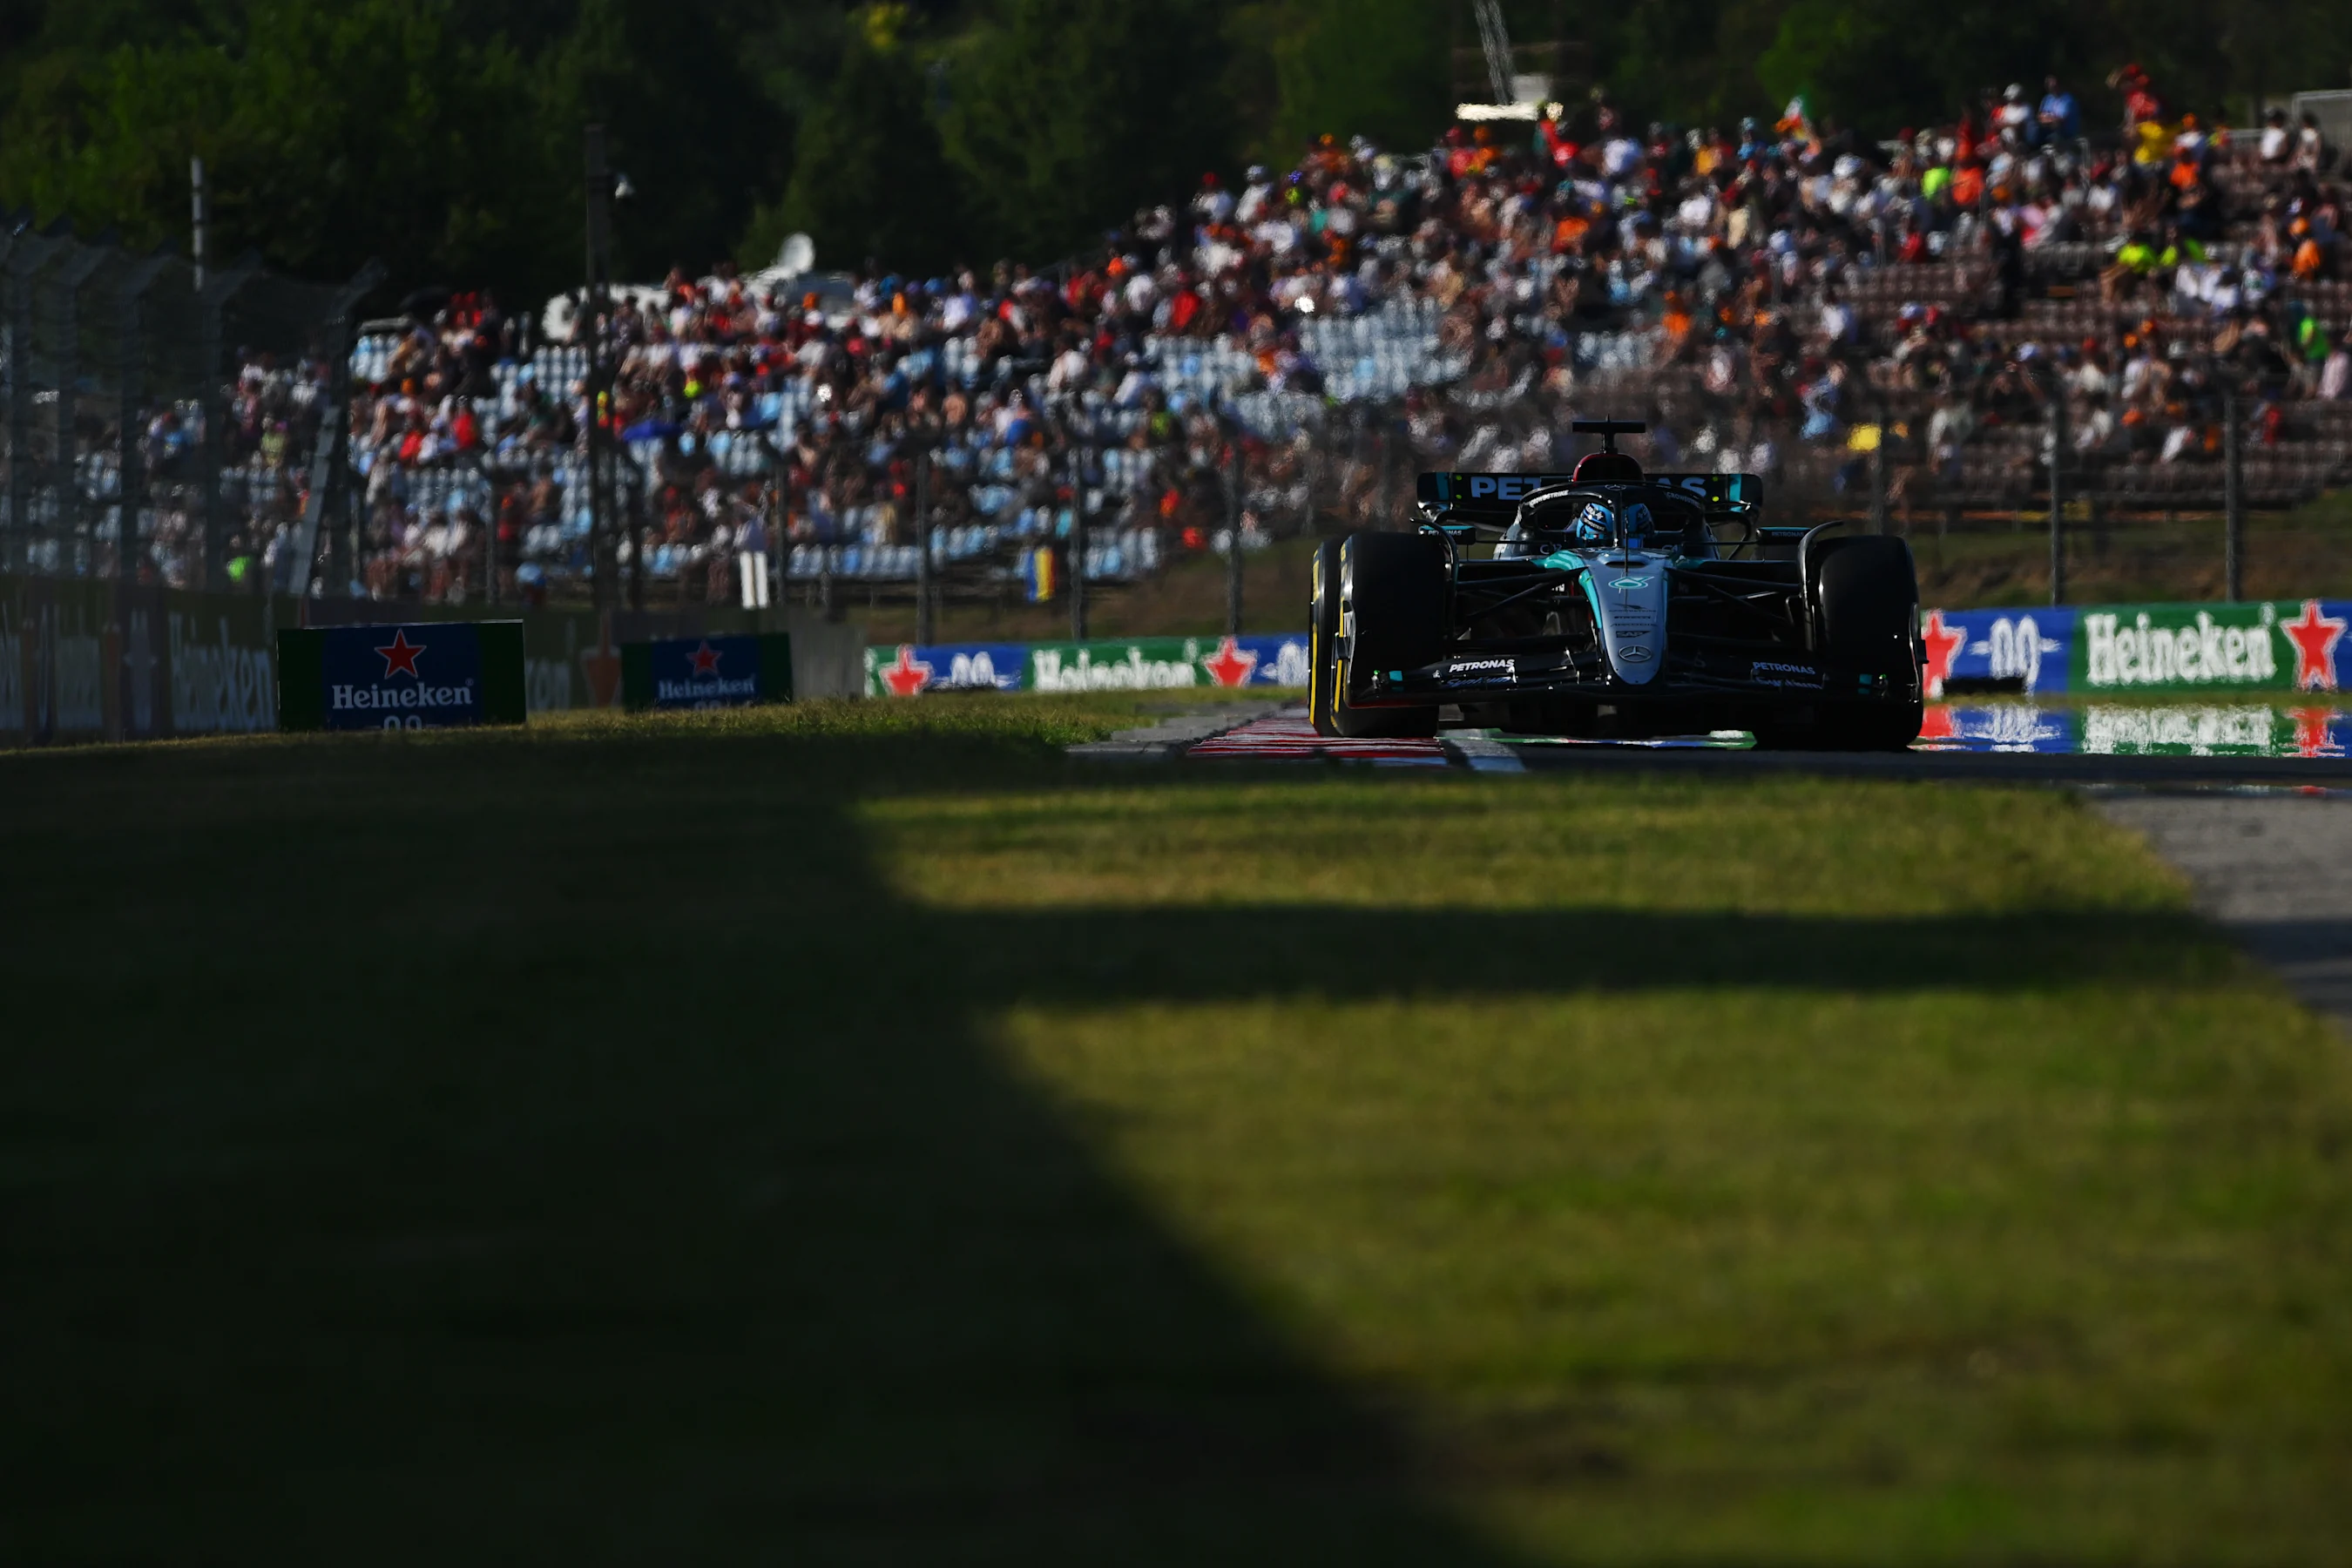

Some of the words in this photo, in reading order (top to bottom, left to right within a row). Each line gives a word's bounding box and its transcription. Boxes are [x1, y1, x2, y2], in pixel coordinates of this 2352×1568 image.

[2085, 611, 2277, 685] Heineken
[1449, 659, 1516, 672] PETRONAS
[1752, 661, 1816, 675] PETRONAS
[332, 682, 473, 709] Heineken
[659, 676, 757, 700] Heineken
